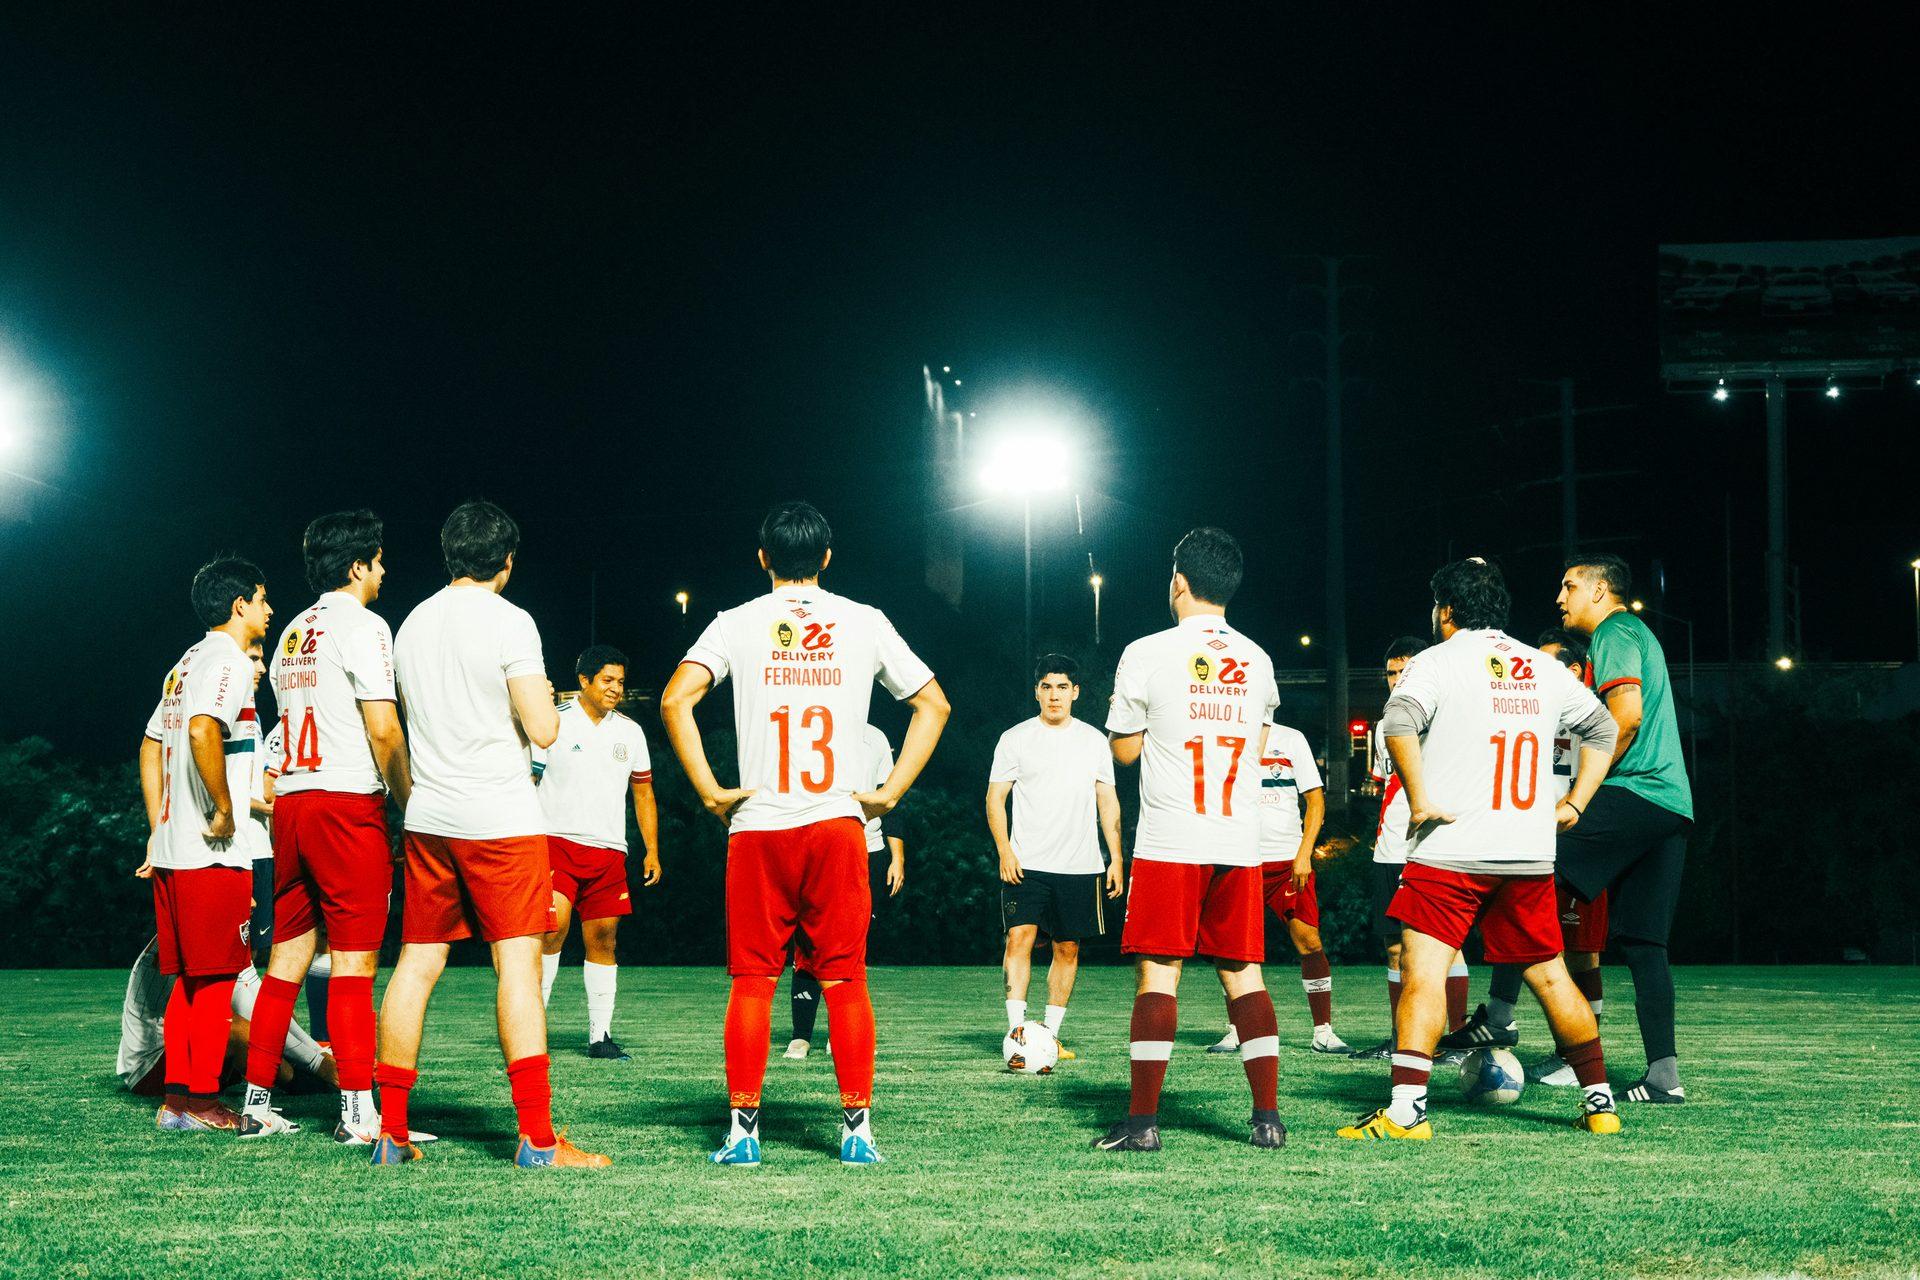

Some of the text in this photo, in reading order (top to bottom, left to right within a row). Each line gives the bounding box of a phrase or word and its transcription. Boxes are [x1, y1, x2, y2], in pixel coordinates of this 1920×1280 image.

[802, 622, 836, 651] Zé
[281, 656, 317, 667] DELIVERY
[377, 631, 392, 685] ZINZANE
[772, 651, 834, 661] DELIVERY
[1510, 656, 1535, 681] Zé
[764, 667, 842, 686] FERNANDO
[1218, 657, 1250, 684] Zé
[214, 665, 231, 709] ZINZANE
[1190, 684, 1248, 696] DELIVERY
[1491, 681, 1537, 691] DELIVERY
[1189, 702, 1232, 721] SAULO
[1493, 697, 1540, 715] ROGERIO
[280, 706, 323, 775] 14
[770, 705, 835, 794] 13
[1184, 735, 1246, 817] 17
[1490, 730, 1539, 811] 10
[251, 1090, 268, 1105] FS
